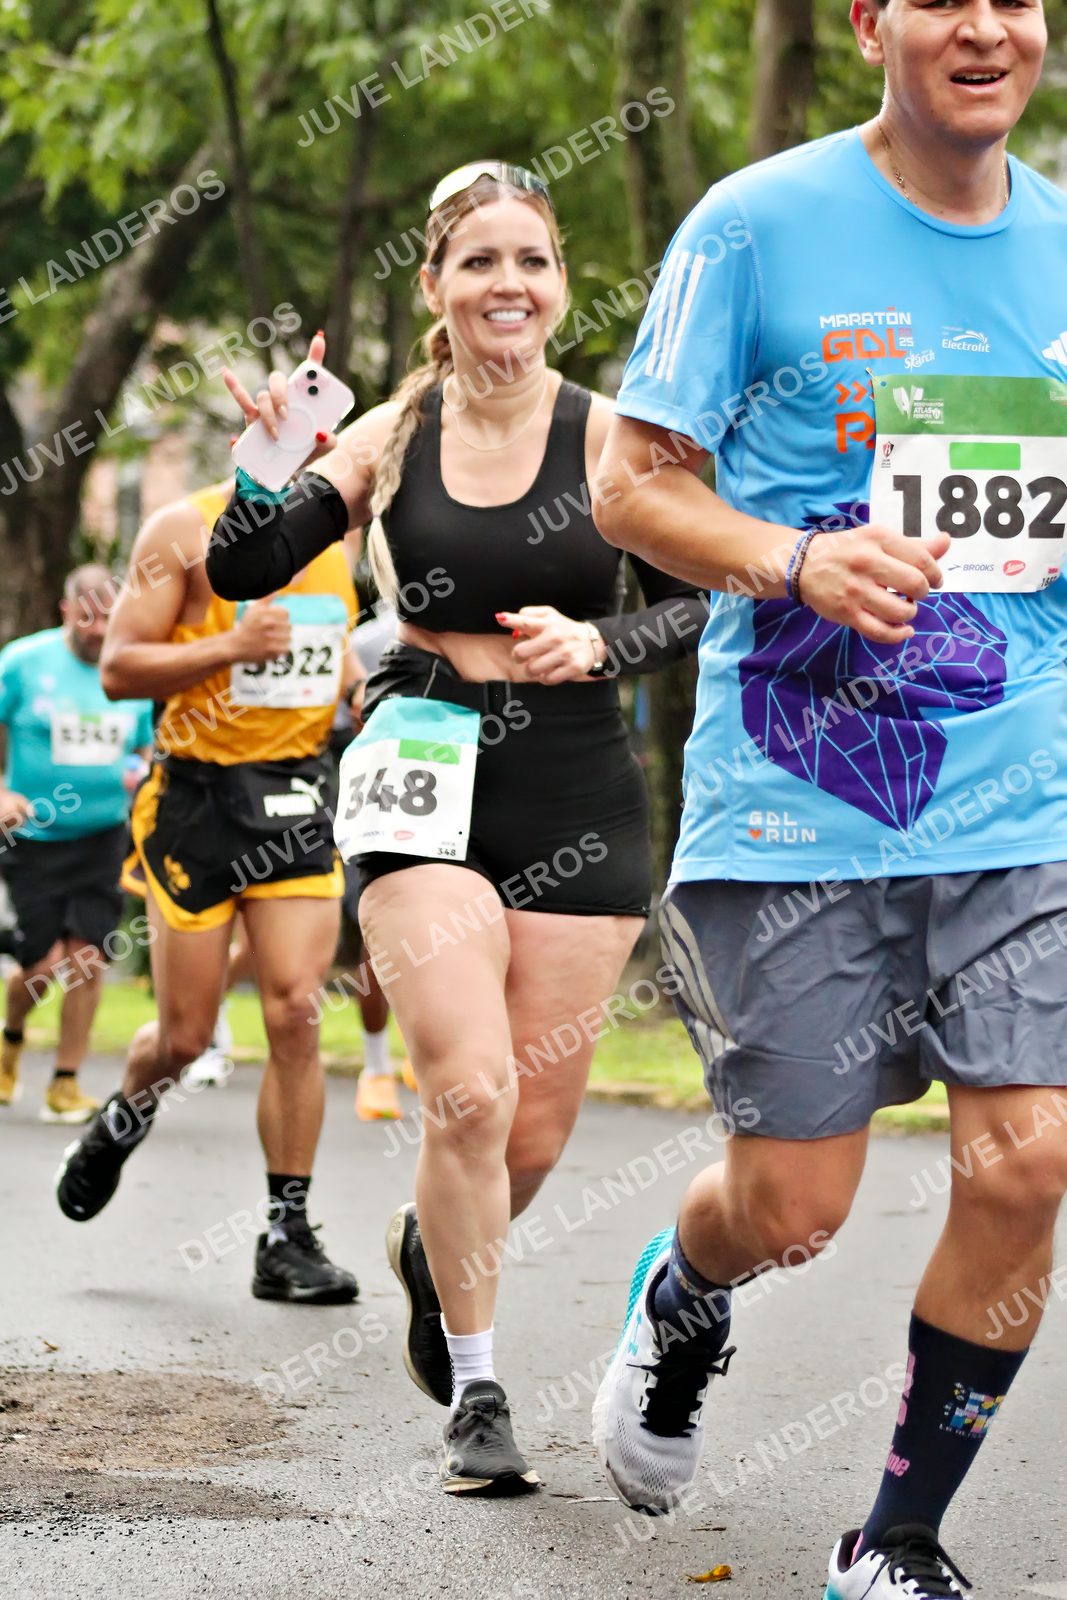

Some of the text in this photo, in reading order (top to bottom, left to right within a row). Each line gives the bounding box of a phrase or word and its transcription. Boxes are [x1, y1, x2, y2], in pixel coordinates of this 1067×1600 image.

[822, 328, 907, 363] GDL
[899, 337, 914, 347] 25
[892, 474, 1067, 538] 1882
[963, 564, 995, 572] BROOKS
[344, 767, 438, 821] 348
[749, 811, 798, 826] GDL
[766, 828, 817, 843] RUN
[437, 847, 456, 857] 348
